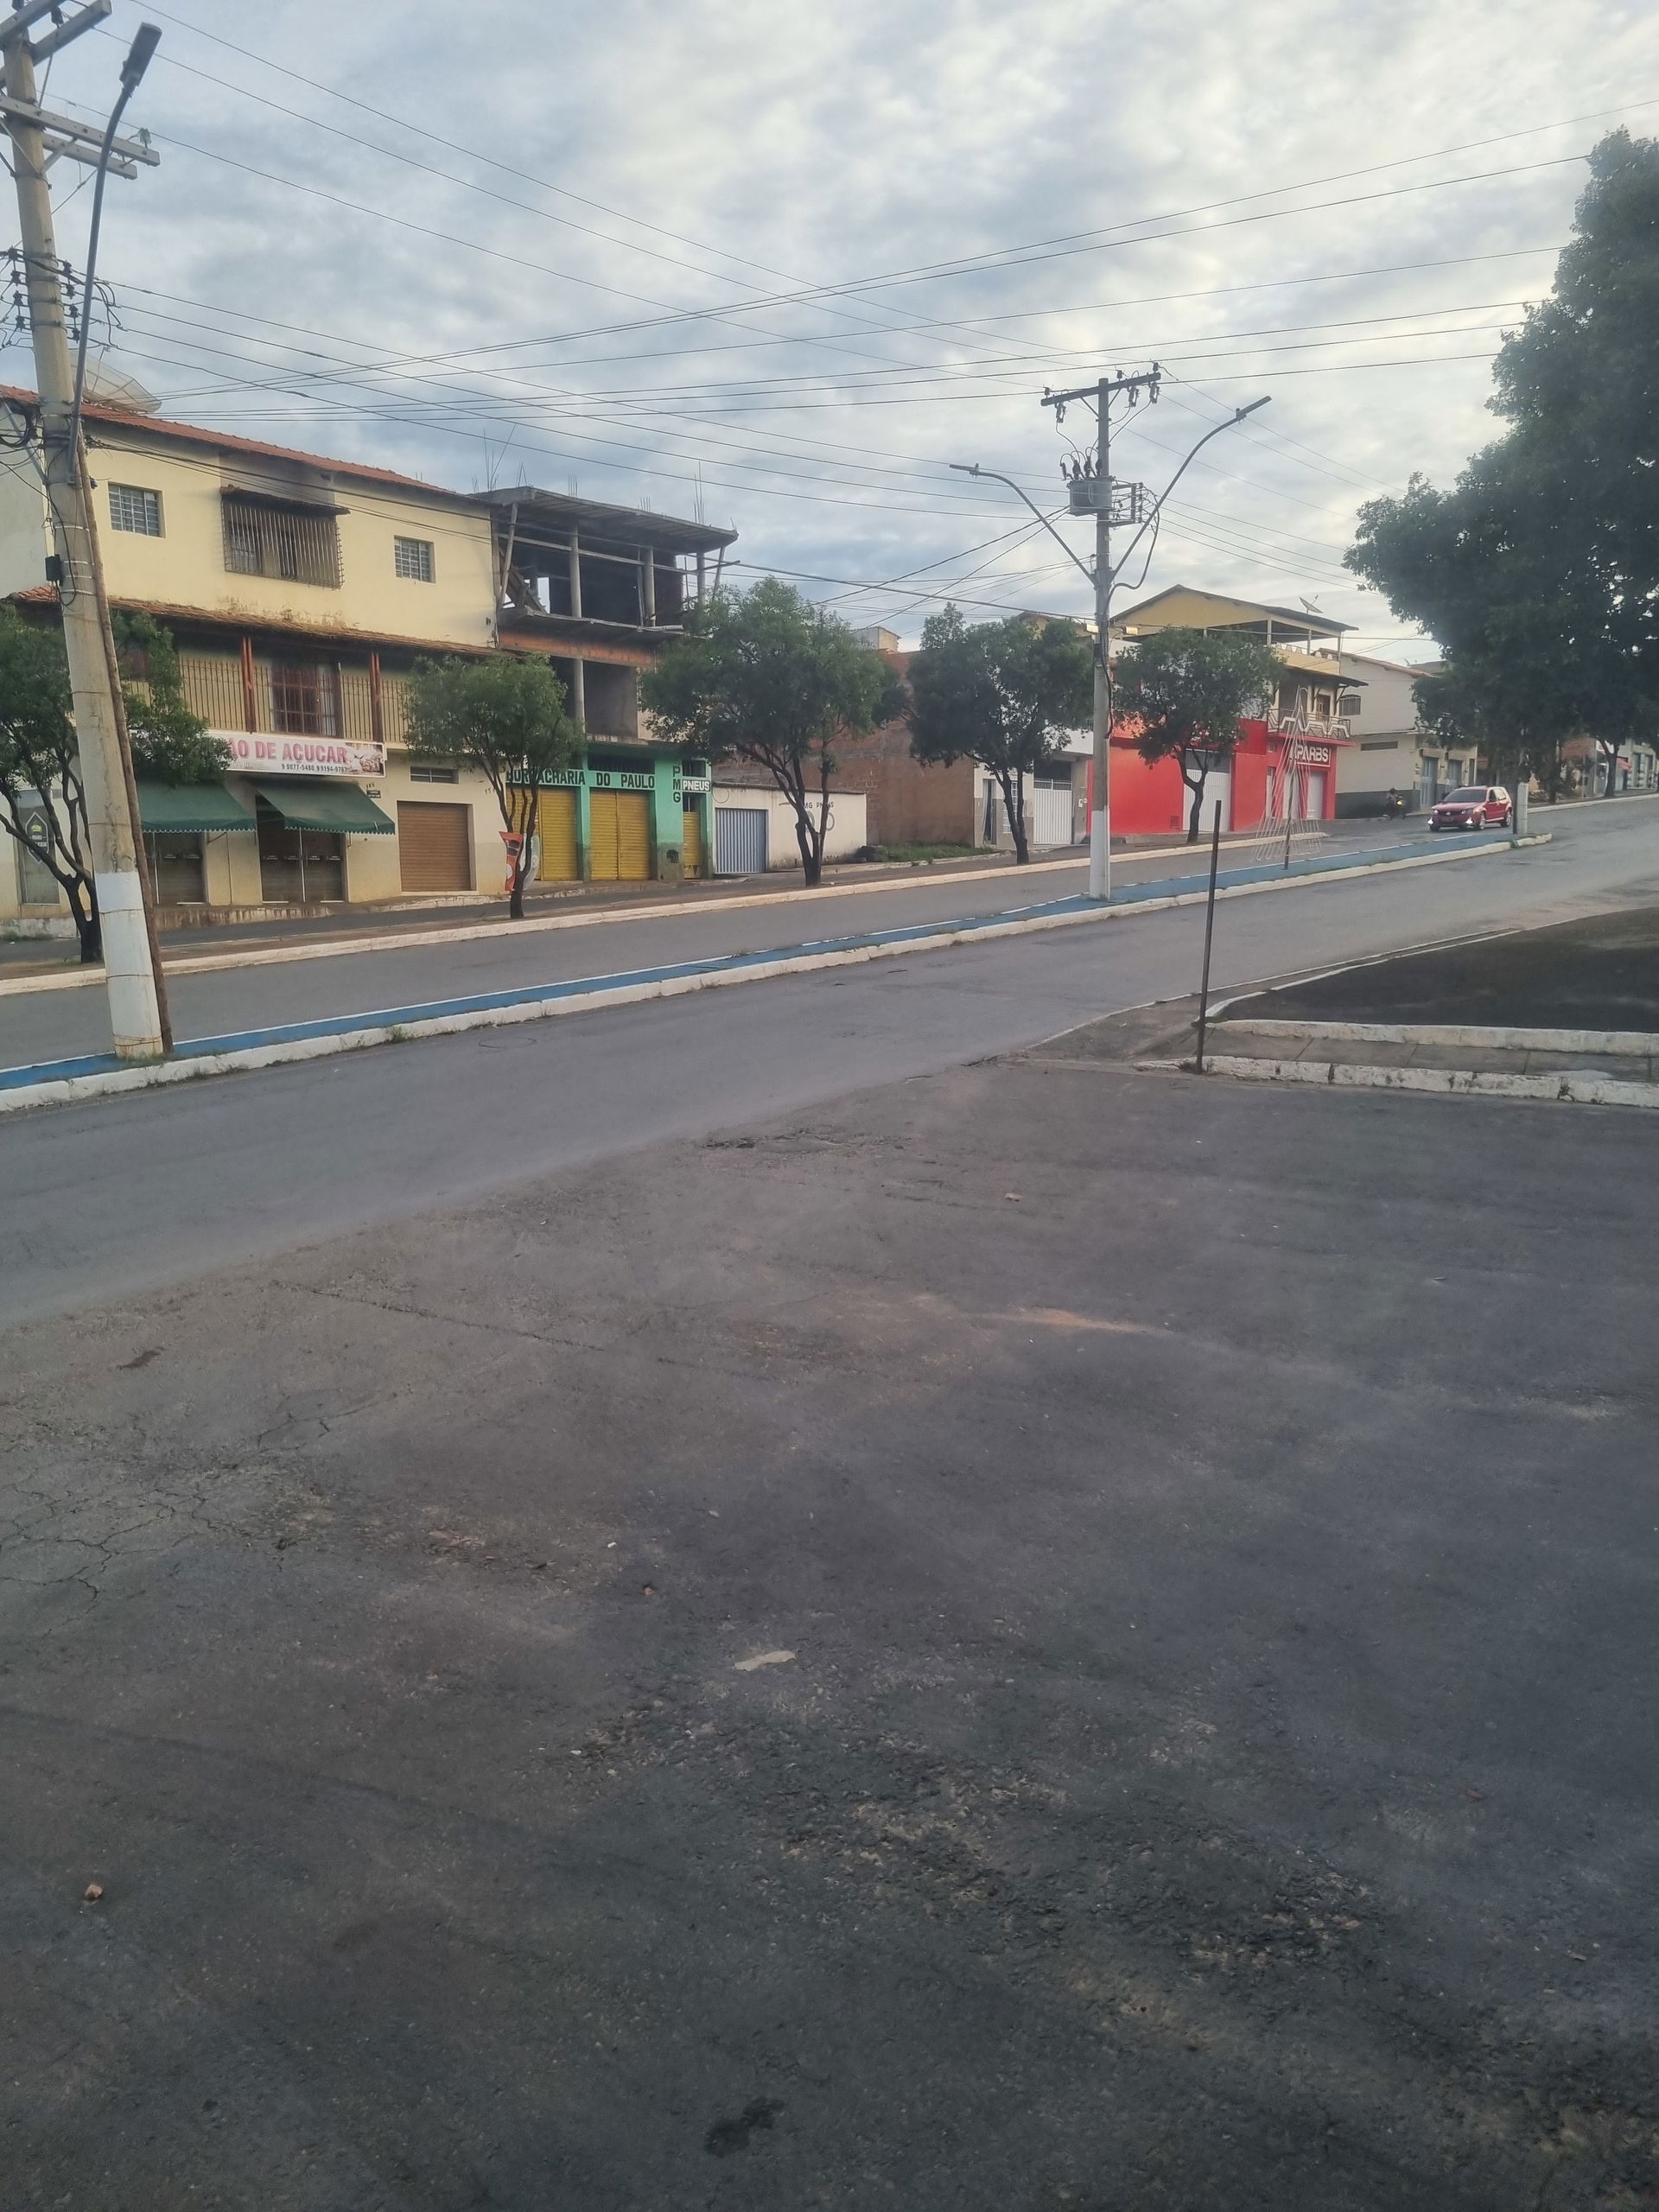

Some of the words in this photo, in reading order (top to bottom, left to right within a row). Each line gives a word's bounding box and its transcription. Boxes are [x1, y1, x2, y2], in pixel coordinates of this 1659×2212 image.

[255, 741, 277, 760] DE
[596, 772, 610, 786] DO
[621, 774, 655, 789] PAULO
[683, 780, 710, 791] PNEUS
